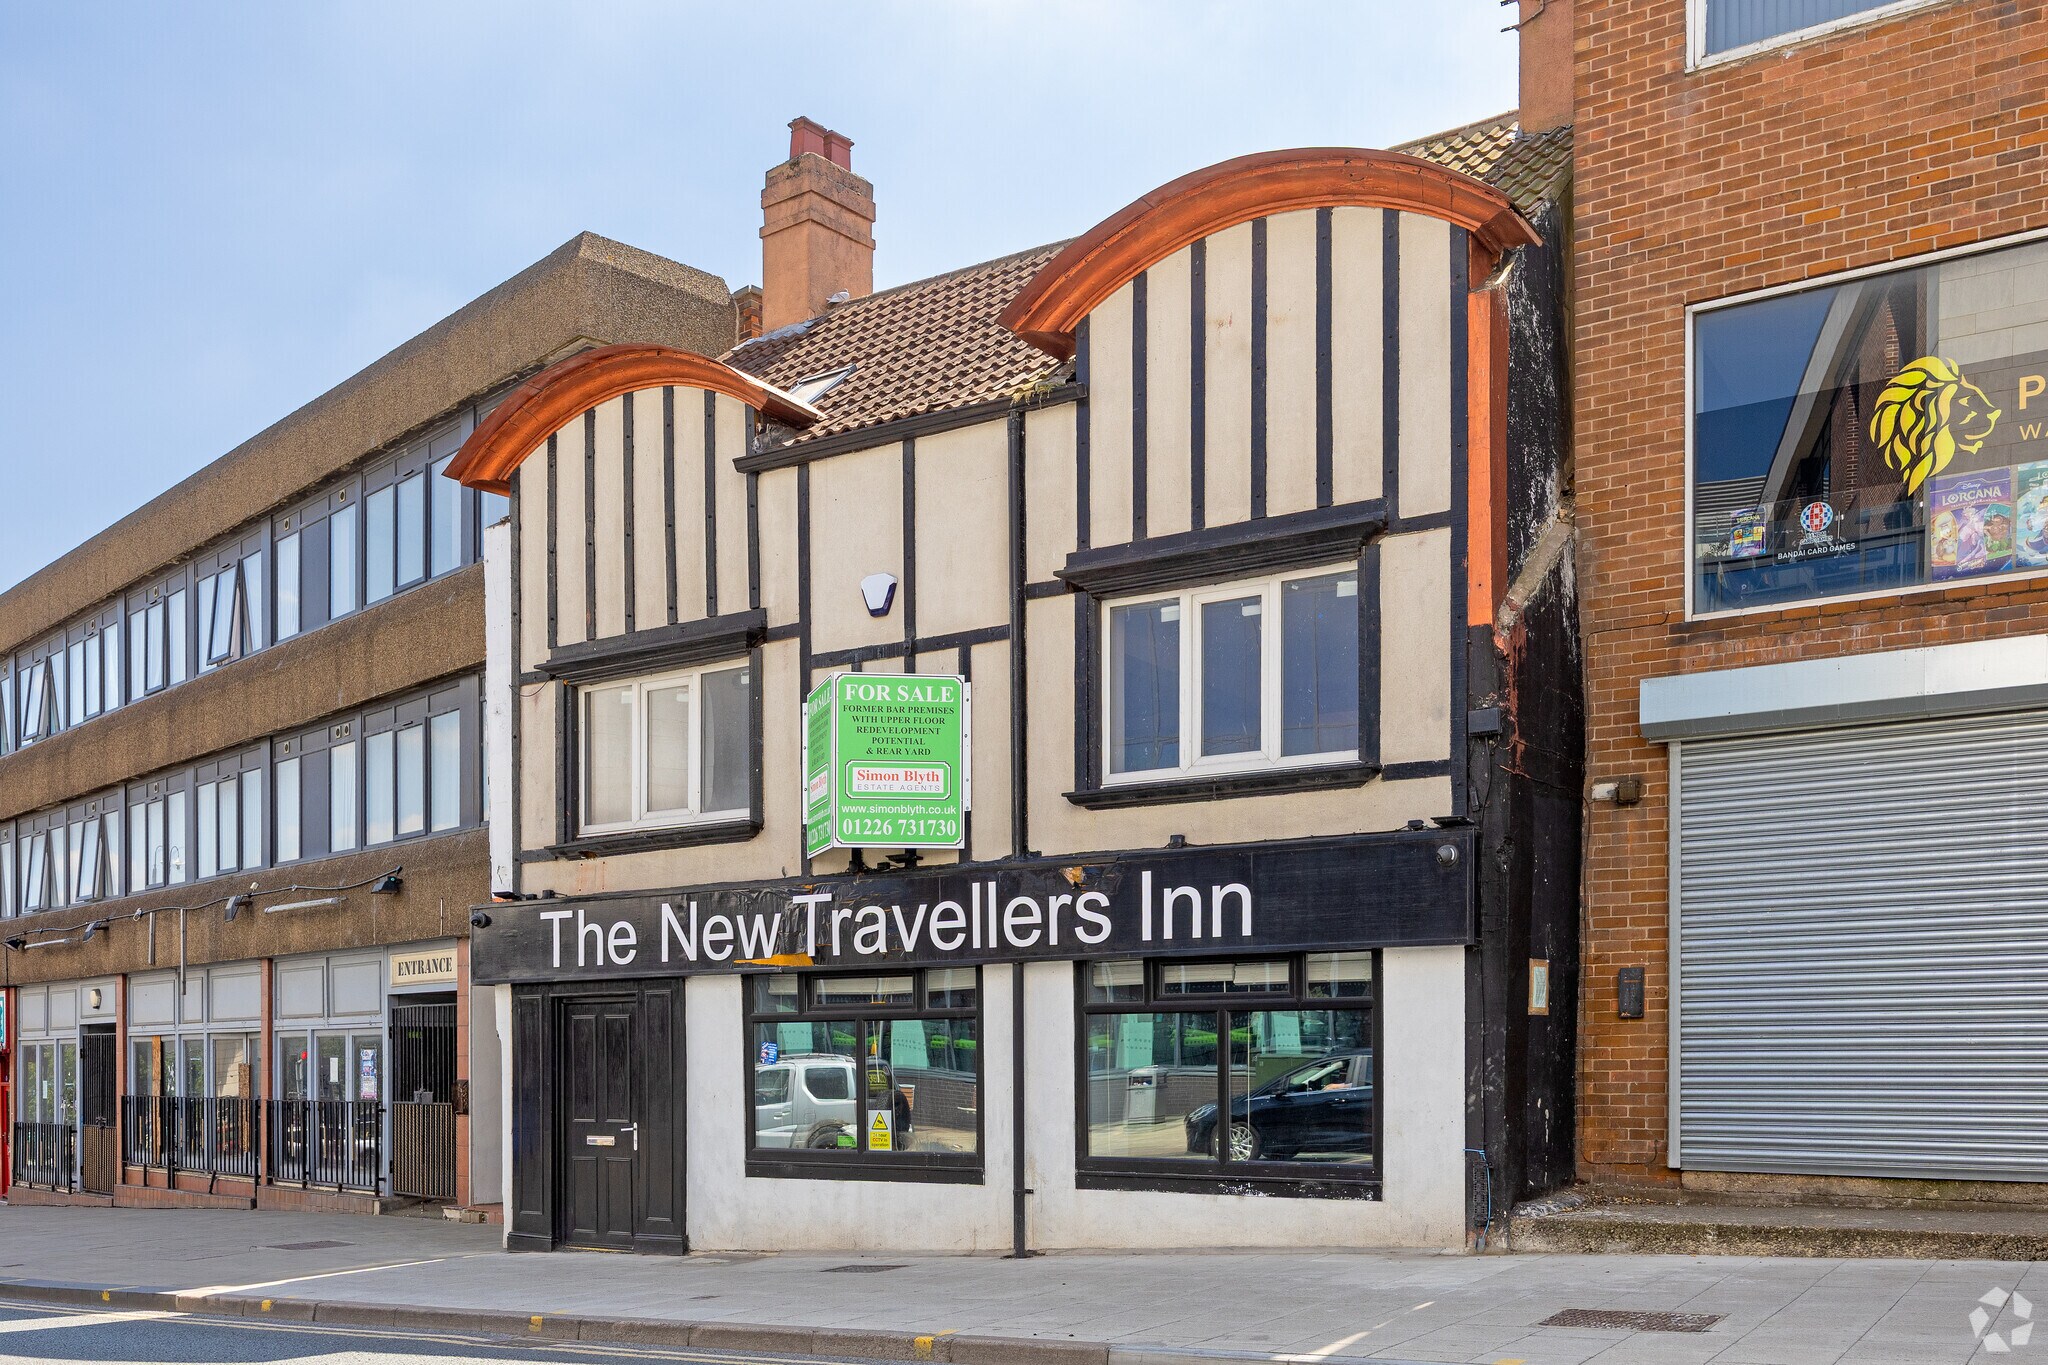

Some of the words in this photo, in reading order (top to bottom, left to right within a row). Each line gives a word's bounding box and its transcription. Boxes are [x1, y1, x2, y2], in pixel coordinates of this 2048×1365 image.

[2018, 422, 2048, 441] W
[1941, 485, 2002, 507] LORCANA
[1777, 549, 1806, 560] BANDAI
[1807, 546, 1828, 558] CARD
[1829, 542, 1856, 554] GAMES
[844, 683, 892, 702] FOR
[897, 684, 955, 703] SALE
[843, 704, 884, 713] FORMER
[886, 705, 906, 714] BAR
[908, 706, 955, 715] PREMISES
[852, 715, 878, 724] WITH
[880, 716, 911, 724] UPPER
[913, 716, 946, 725] FLOOR
[856, 725, 941, 736] REDEVELOPMENT
[871, 736, 926, 746] POTENTIAL
[865, 746, 874, 755] &
[876, 747, 902, 756] REAR
[904, 747, 931, 756] YARD
[856, 769, 899, 782] Simon
[903, 770, 940, 785] Blyth
[857, 783, 894, 791] ESTATE
[900, 784, 940, 792] AGENTS
[841, 803, 957, 817] www.simonblyth.co.uk
[842, 818, 893, 836] 01226
[897, 818, 957, 837] 731730
[539, 908, 638, 968] The
[660, 900, 782, 963] New
[792, 880, 1113, 957] Travellers
[1141, 870, 1252, 942] Inn
[397, 956, 453, 977] ENTRANCE
